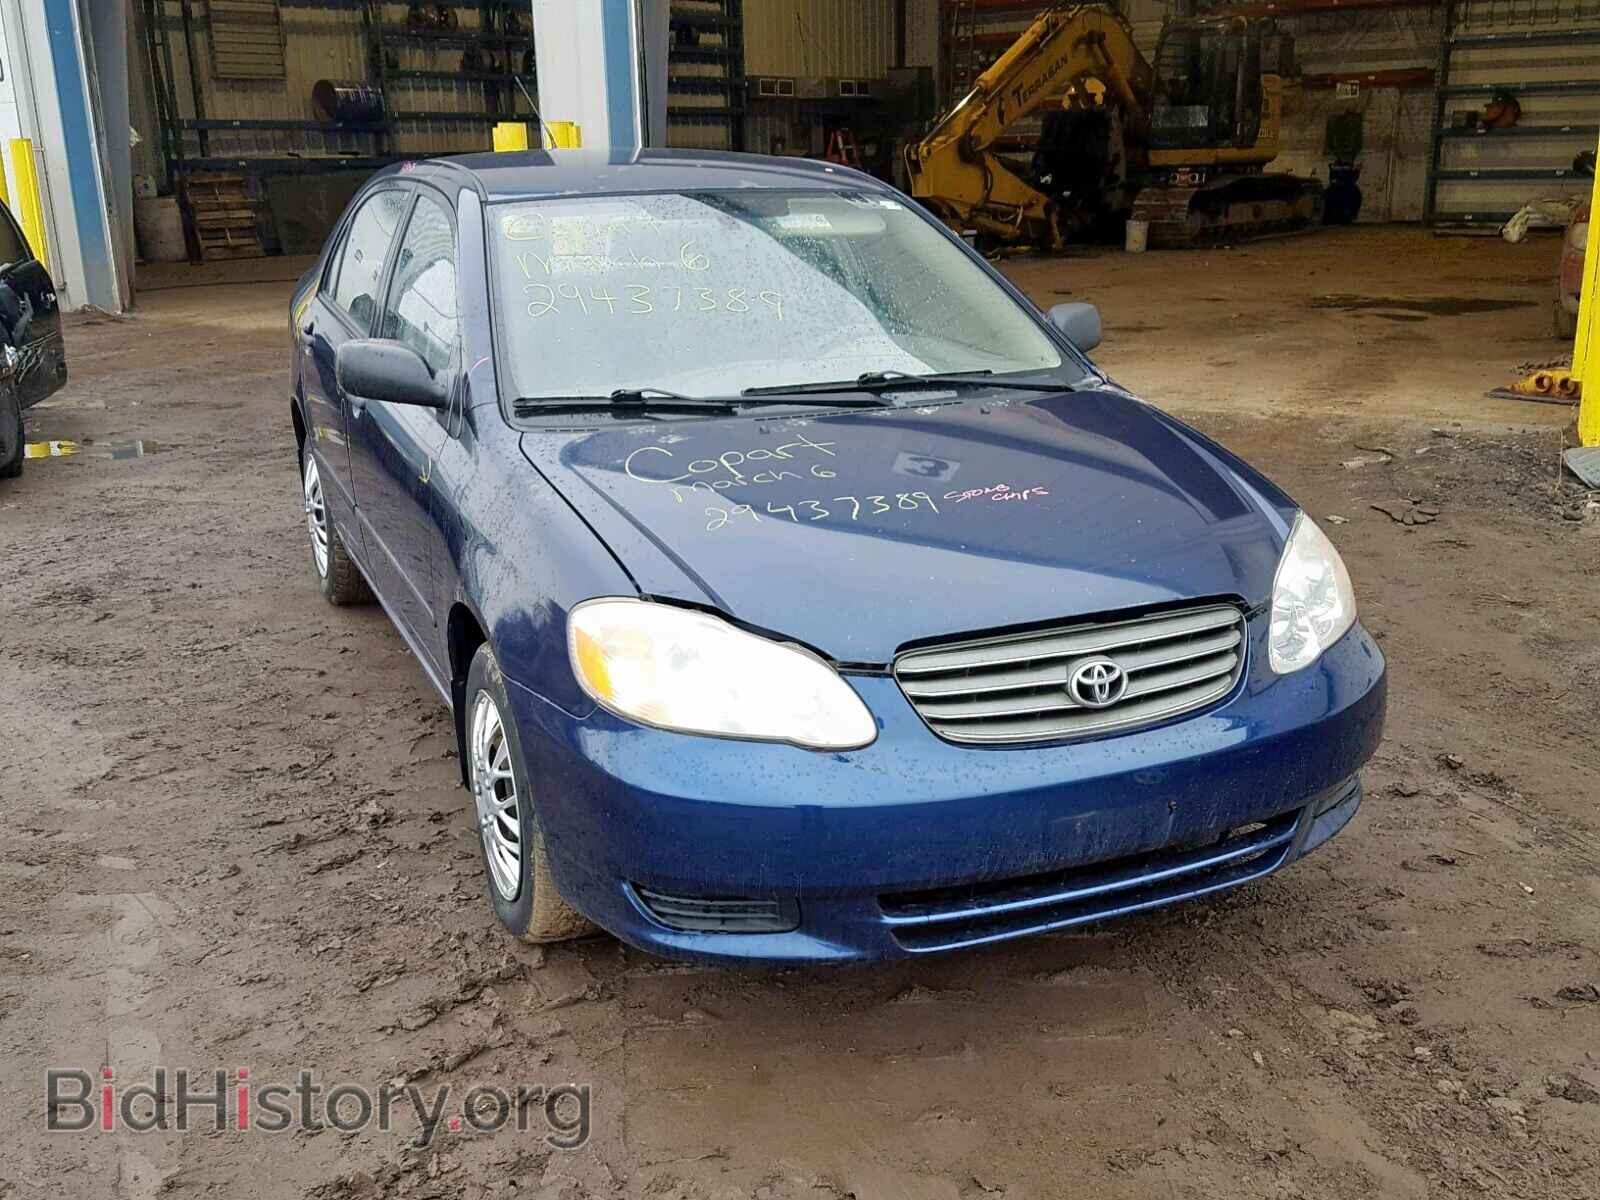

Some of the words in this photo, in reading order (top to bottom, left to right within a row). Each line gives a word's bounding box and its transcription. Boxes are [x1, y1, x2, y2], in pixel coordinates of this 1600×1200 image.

[680, 241, 711, 272] 6
[523, 283, 786, 321] 29437389
[625, 434, 836, 484] Copart
[811, 464, 837, 479] 6
[704, 491, 939, 531] 29437389
